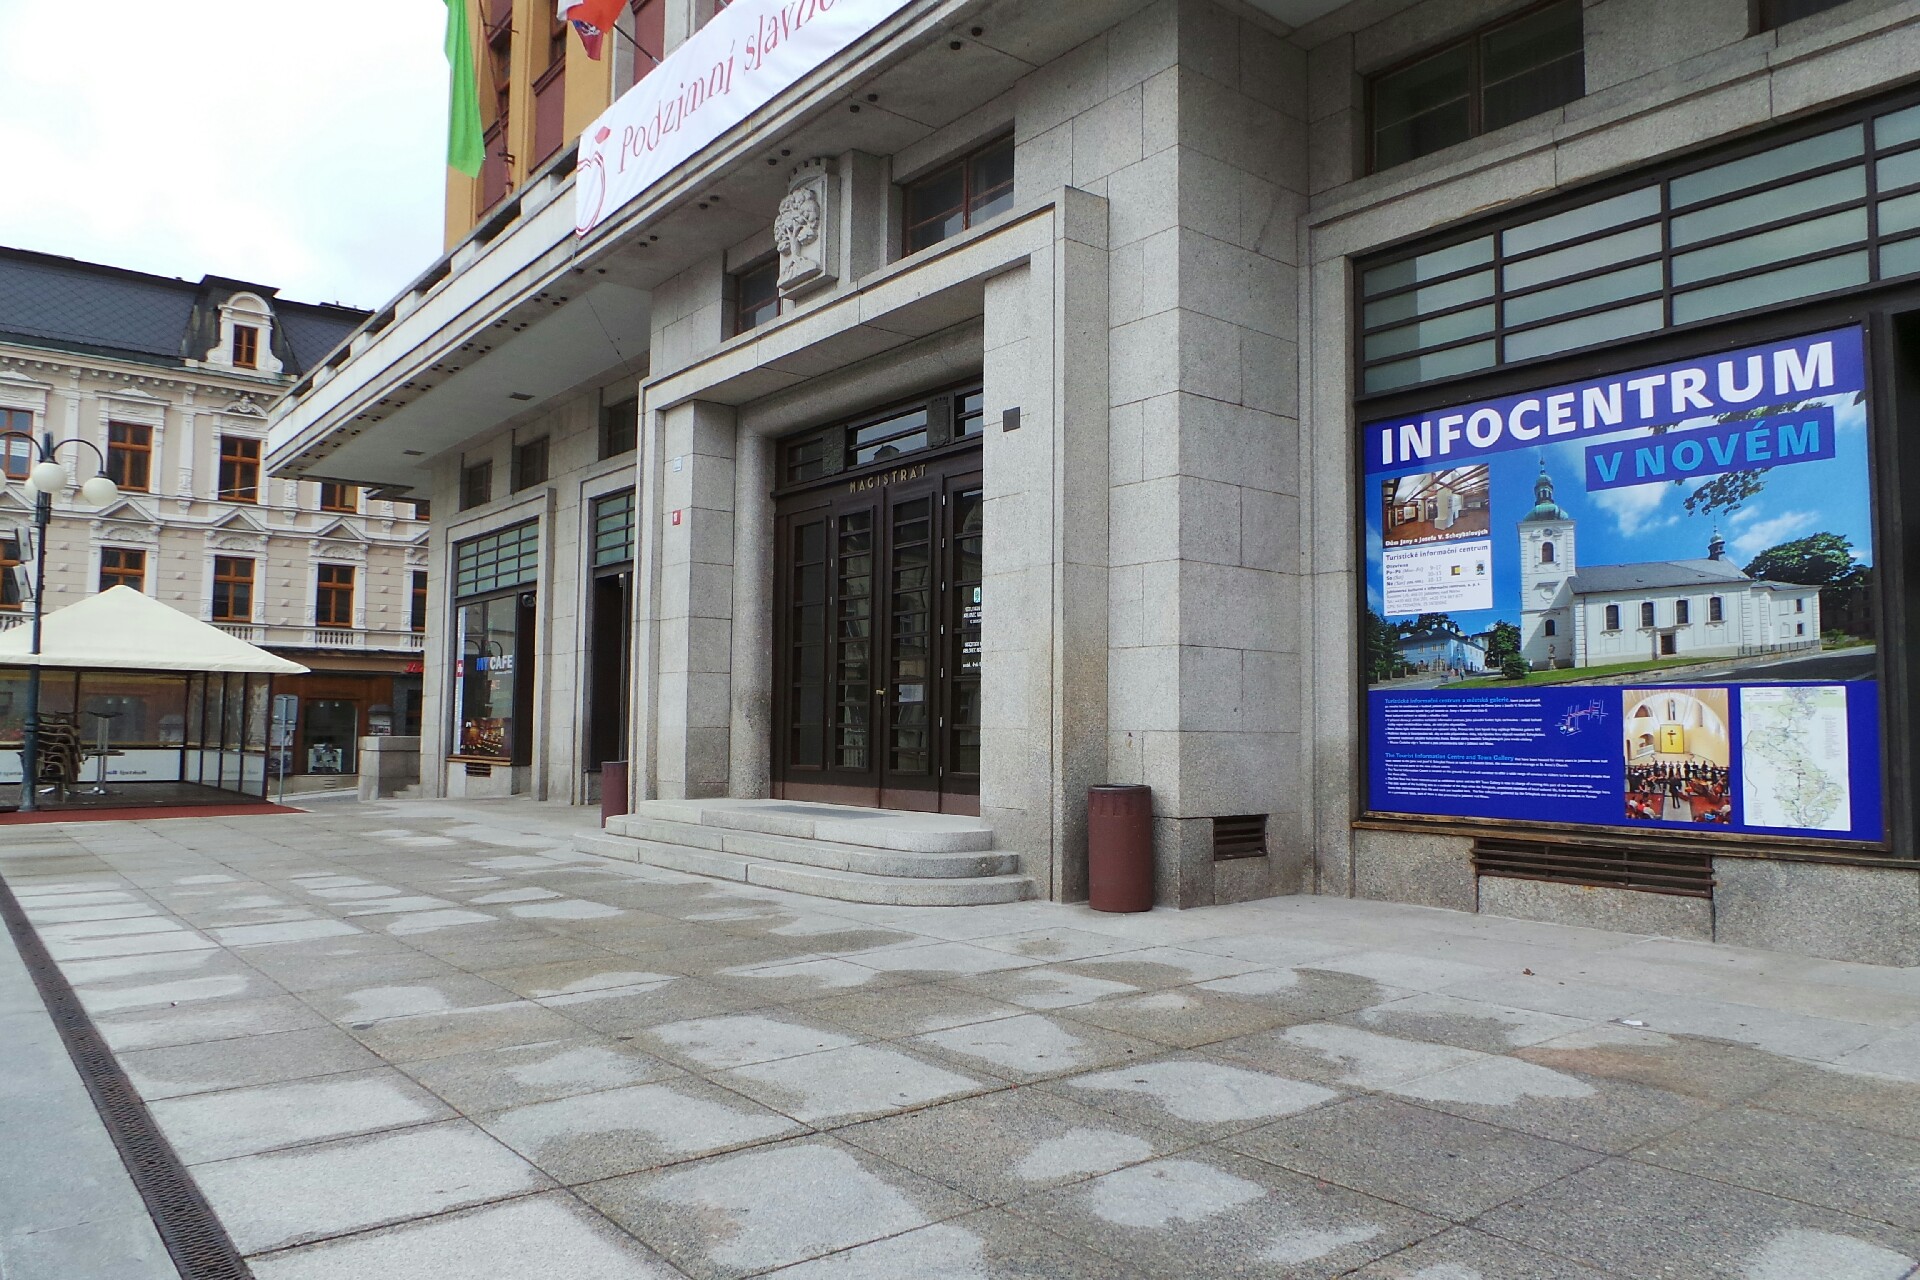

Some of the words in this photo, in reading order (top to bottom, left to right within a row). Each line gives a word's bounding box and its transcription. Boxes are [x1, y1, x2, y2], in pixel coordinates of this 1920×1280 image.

[1381, 341, 1835, 465] INFOCENTRUM
[1594, 452, 1622, 483] V
[1635, 420, 1821, 477] NOVÉM
[849, 464, 926, 494] MAGISTRÁT
[1386, 552, 1419, 561] Turistické
[1420, 547, 1457, 558] informační
[1458, 545, 1488, 554] centrum
[476, 657, 488, 671] MY
[489, 655, 513, 670] CAFE
[1493, 754, 1515, 762] Gallery
